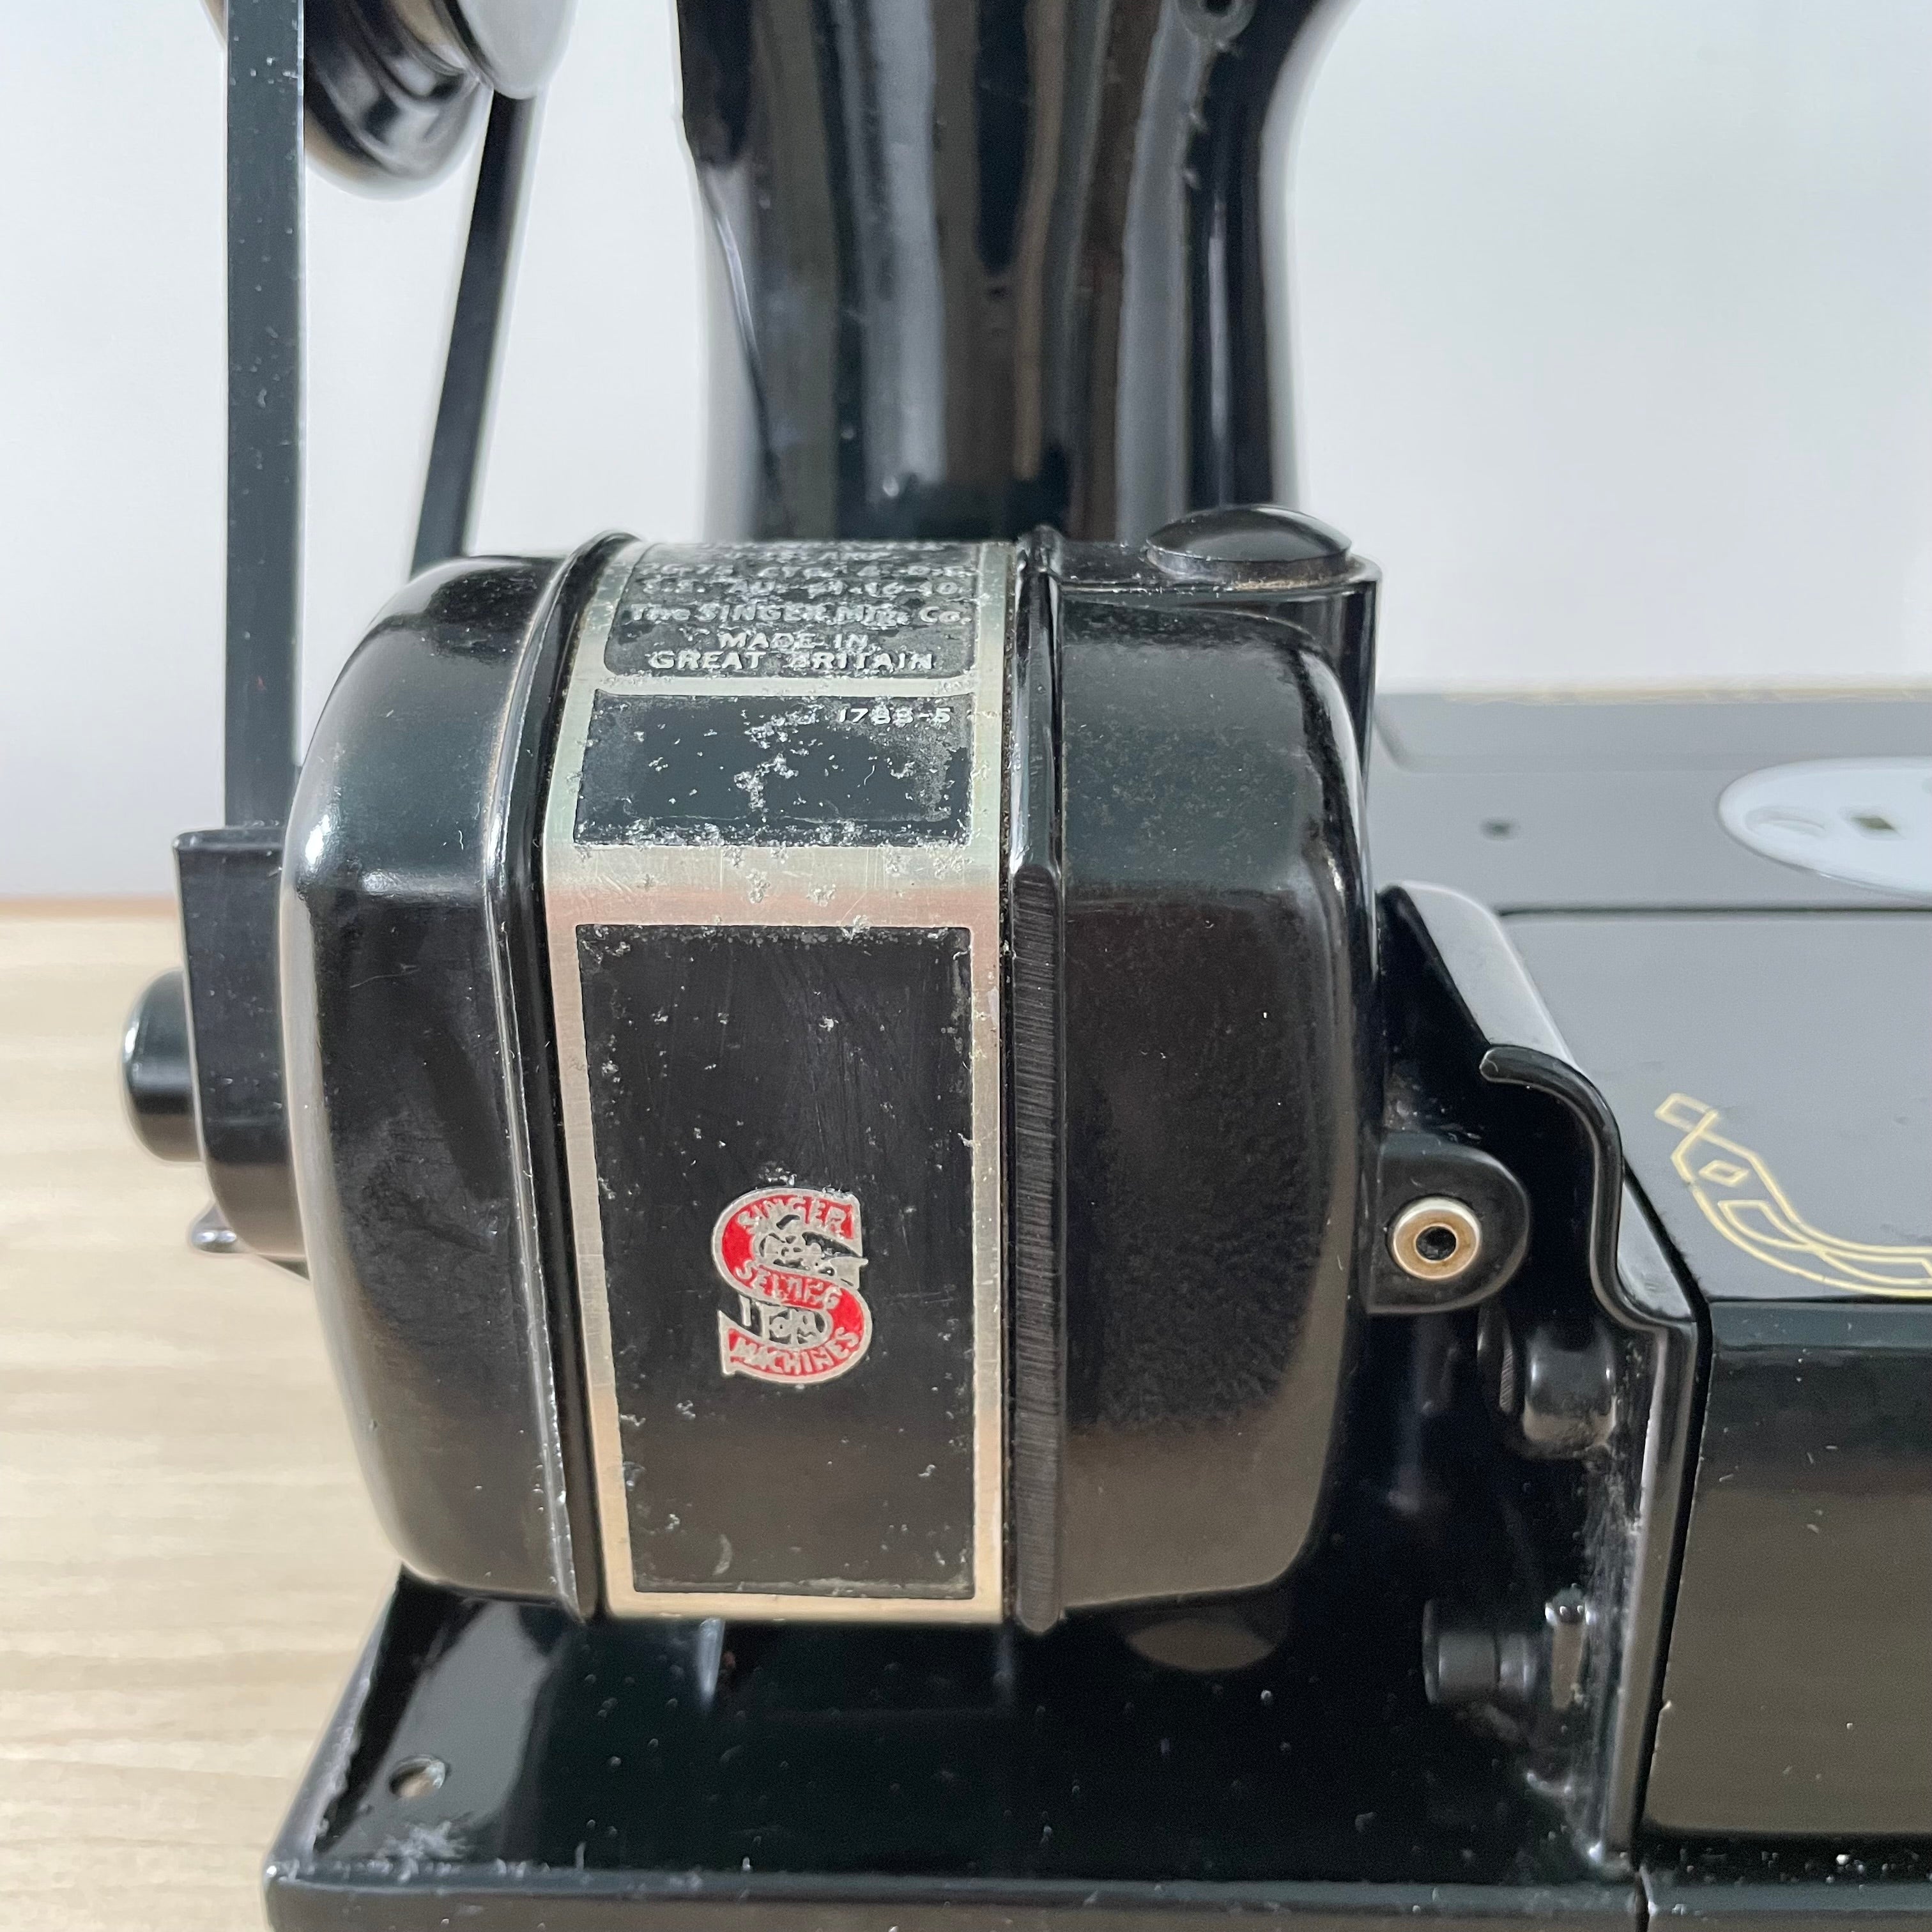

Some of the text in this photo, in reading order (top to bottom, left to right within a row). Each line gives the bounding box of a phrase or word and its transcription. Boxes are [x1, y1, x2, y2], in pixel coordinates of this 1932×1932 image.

[717, 632, 869, 650] MADE IN
[647, 649, 933, 672] GREAT BRITAIN
